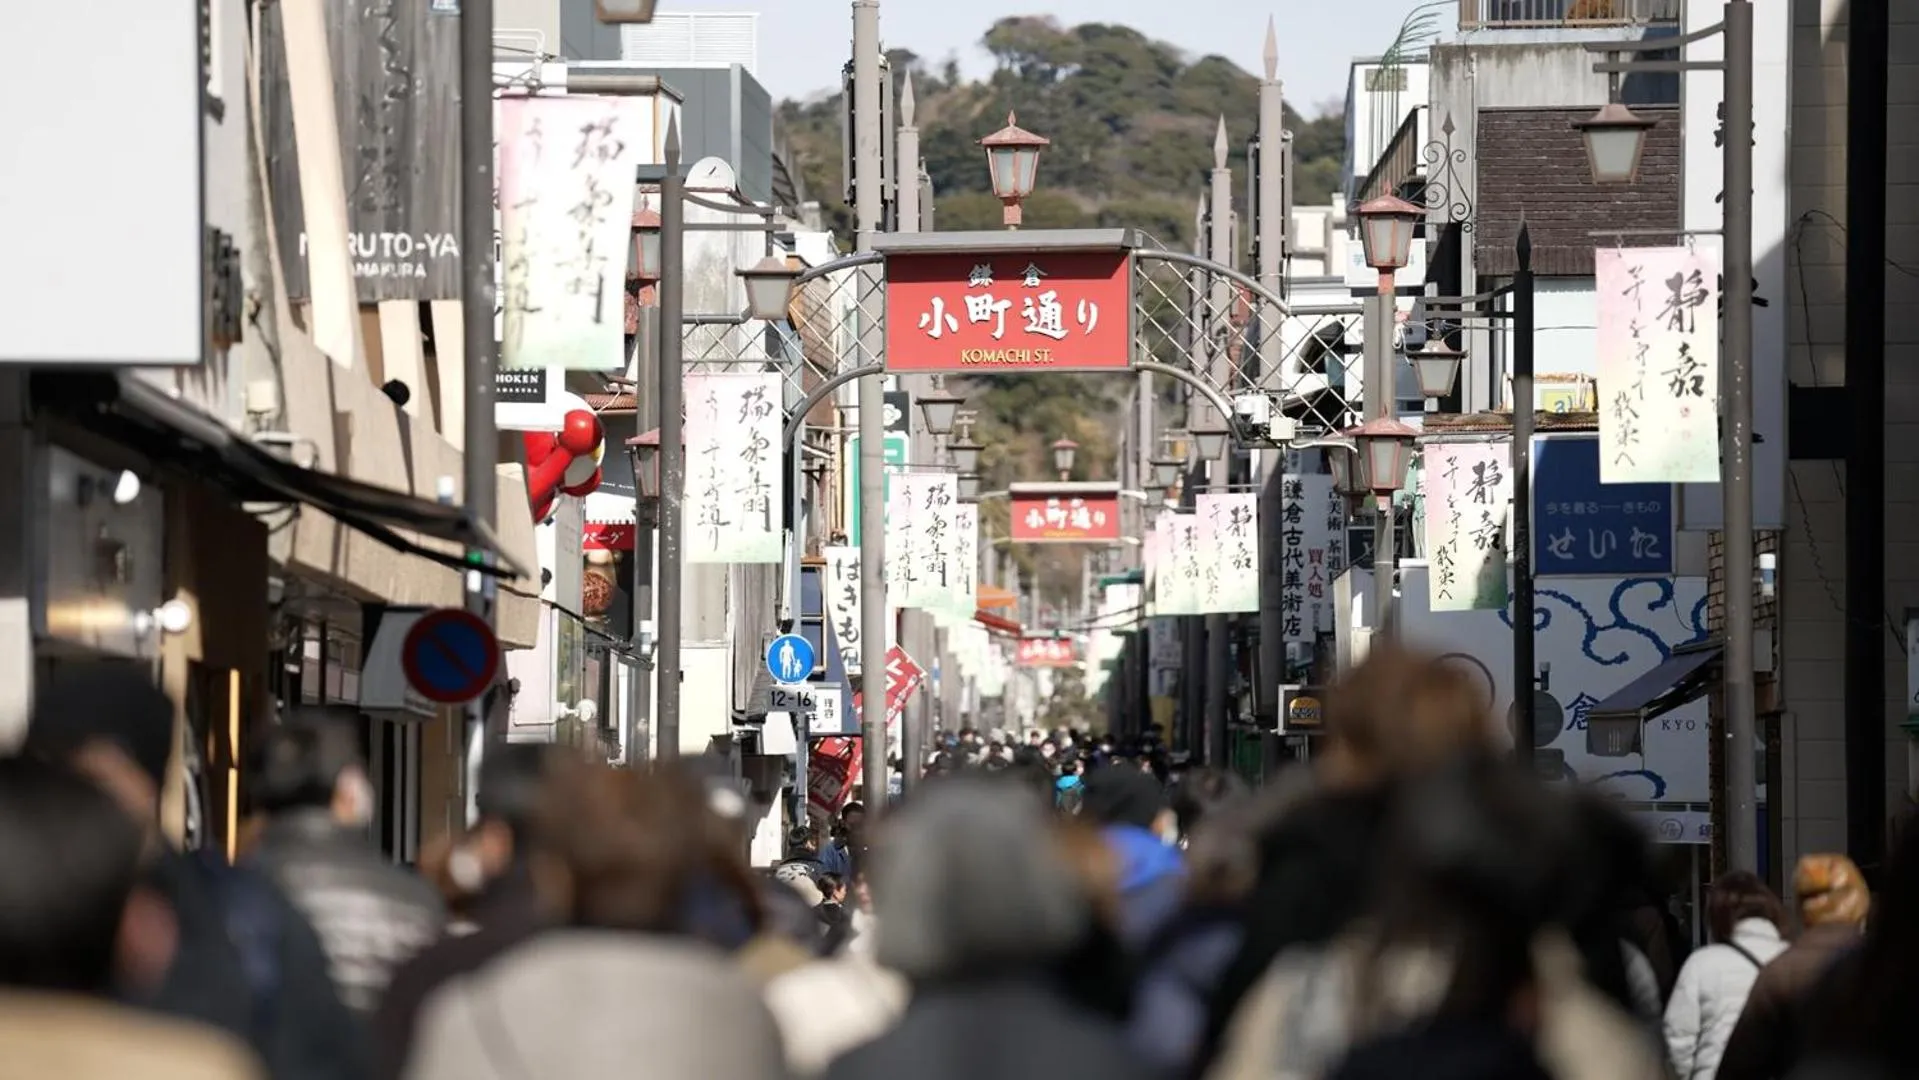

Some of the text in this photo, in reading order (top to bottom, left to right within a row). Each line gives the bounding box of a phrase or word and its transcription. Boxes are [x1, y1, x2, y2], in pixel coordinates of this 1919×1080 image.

[299, 232, 460, 258] RUTO-YA
[968, 262, 1048, 288] 鎌倉
[918, 290, 1099, 340] 小町通り
[961, 348, 1054, 364] KOMACHI ST.
[1546, 526, 1663, 560] せいた
[1282, 479, 1305, 637] 鎌倉古代美術店
[771, 690, 812, 707] 12-16
[1661, 719, 1696, 731] KYO
